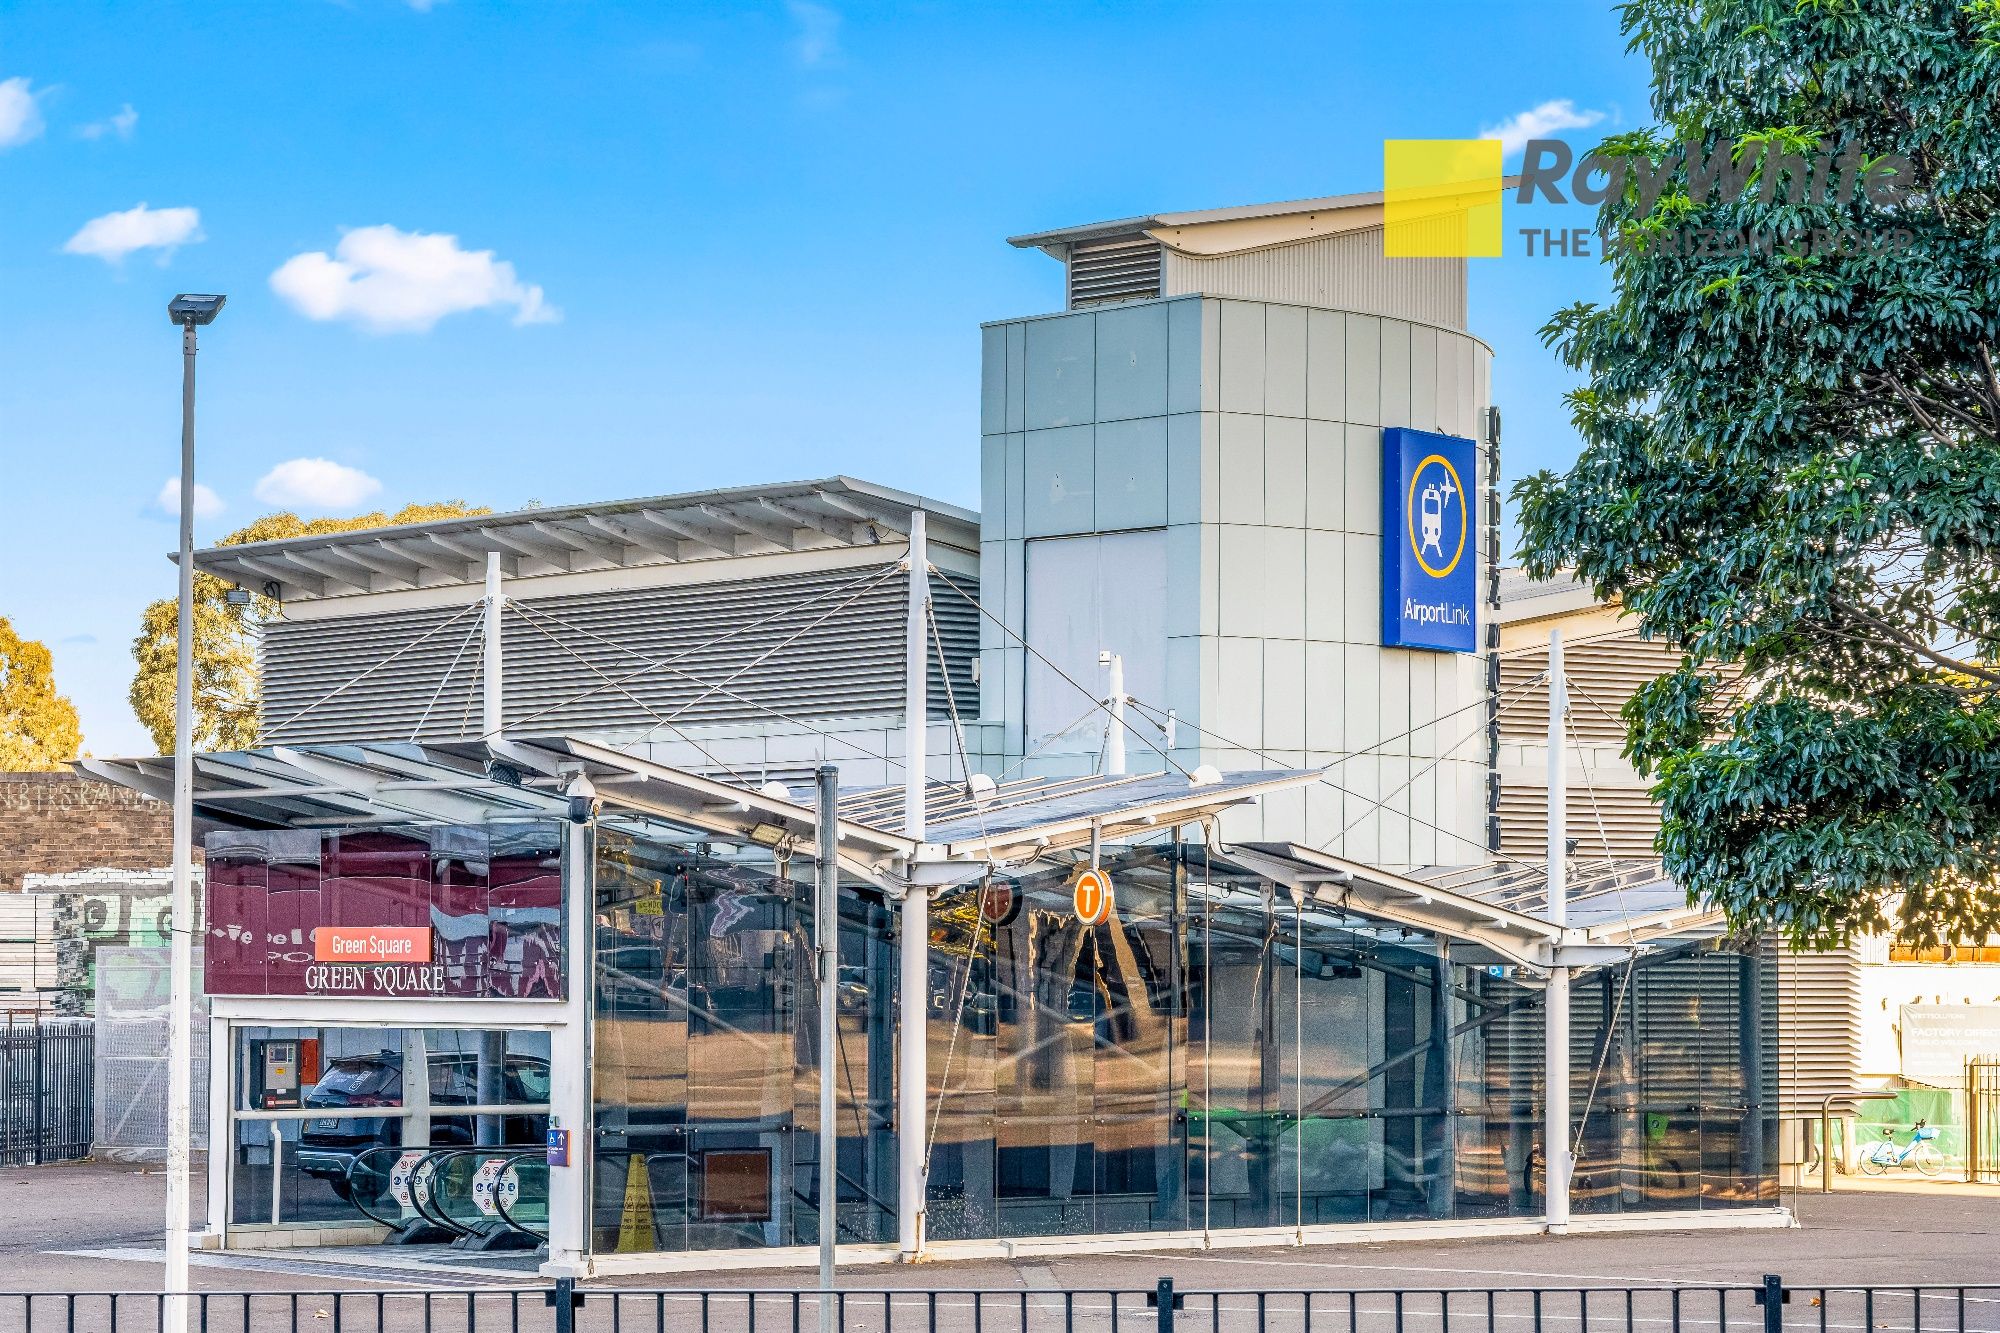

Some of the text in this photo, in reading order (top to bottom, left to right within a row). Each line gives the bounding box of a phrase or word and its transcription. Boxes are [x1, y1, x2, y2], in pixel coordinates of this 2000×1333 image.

[1404, 597, 1470, 626] AirportLink
[1082, 885, 1095, 913] T
[332, 936, 367, 954] Green
[369, 935, 412, 958] Square
[305, 966, 445, 995] GREEN SQUARE
[1911, 1028, 1962, 1037] FACTORY
